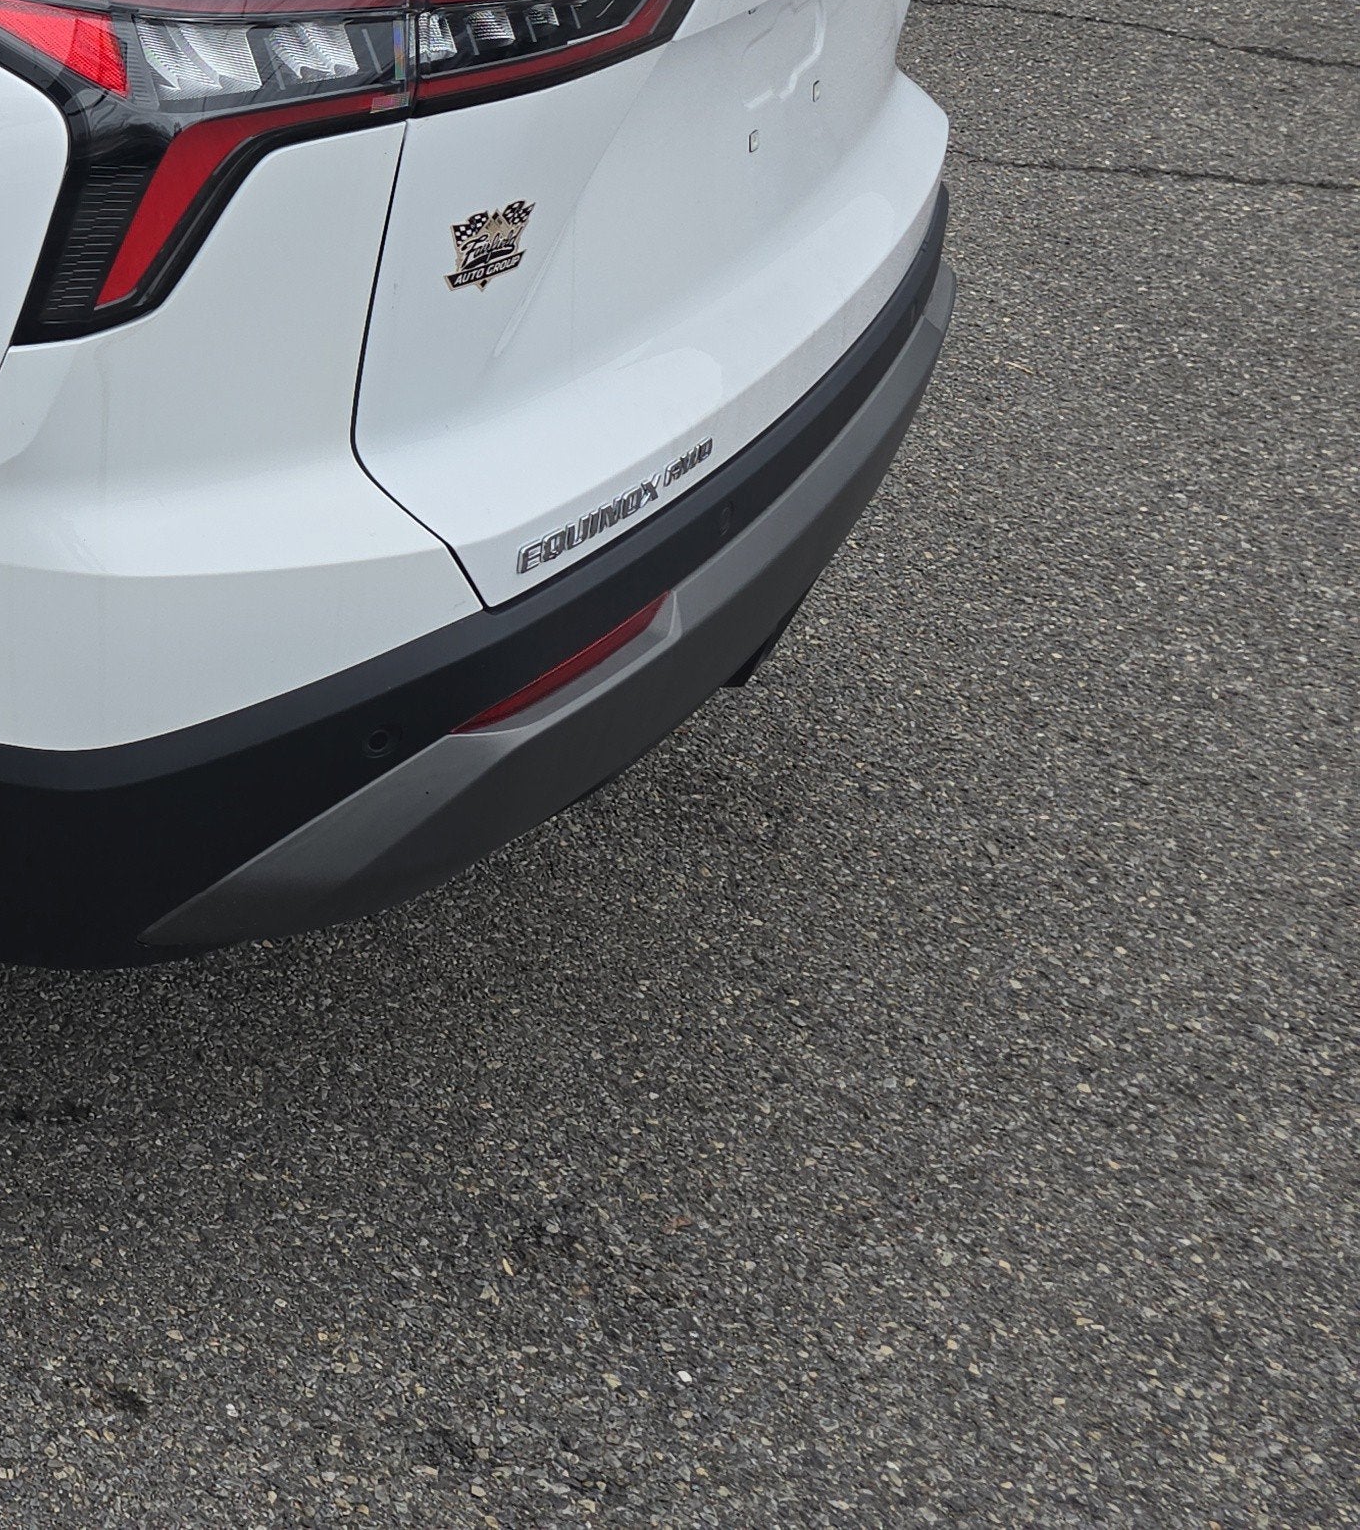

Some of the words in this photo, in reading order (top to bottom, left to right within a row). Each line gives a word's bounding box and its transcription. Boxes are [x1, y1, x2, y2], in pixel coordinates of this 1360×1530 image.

[461, 226, 523, 268] Fairfield
[454, 268, 485, 285] AUTO
[486, 255, 521, 275] GROUP
[515, 473, 661, 574] EQUINOX
[663, 436, 713, 487] AWD
